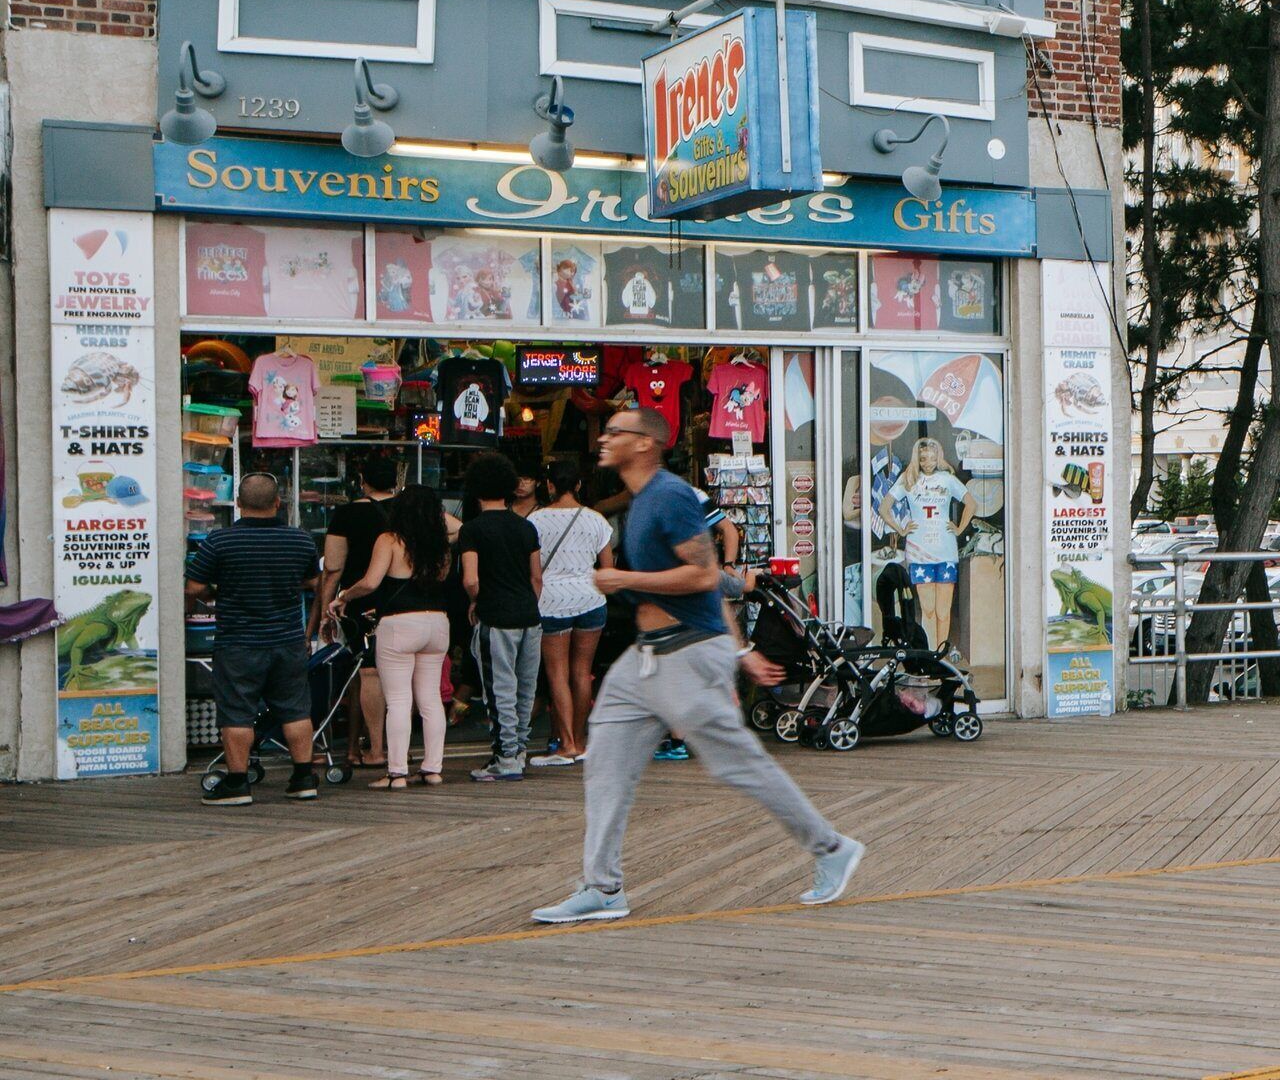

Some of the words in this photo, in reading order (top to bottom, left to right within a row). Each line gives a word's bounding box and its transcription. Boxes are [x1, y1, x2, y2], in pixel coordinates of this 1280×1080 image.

[237, 96, 301, 119] 1239
[653, 34, 745, 177] Irene's
[693, 136, 714, 161] Gifts
[717, 131, 724, 152] &
[187, 149, 440, 203] Souvenirs
[668, 146, 748, 204] Souvenirs
[894, 198, 996, 235] Gifts
[74, 271, 130, 286] TOYS
[55, 295, 150, 311] JEWELRY
[76, 324, 132, 336] HERMIT
[80, 337, 128, 348] CRABS
[523, 353, 565, 368] JERSEY
[1060, 350, 1096, 359] HERMIT
[1063, 361, 1094, 369] CRABS
[558, 365, 597, 378] SHORE
[922, 386, 961, 415] GIFTS
[465, 404, 478, 412] YOU
[60, 425, 149, 438] T-SHIRTS
[1051, 432, 1108, 442] T-SHIRTS
[67, 442, 85, 455] &
[91, 442, 144, 455] HATS
[1055, 445, 1065, 456] &
[1071, 446, 1104, 456] HATS
[1054, 508, 1106, 518] LARGEST
[66, 519, 146, 531] LARGEST
[65, 533, 128, 542] SELECTION
[133, 533, 149, 541] OF
[63, 542, 133, 552] SOUVENIRS
[137, 542, 150, 550] IN
[63, 552, 121, 561] ATLANTIC
[126, 551, 150, 559] CITY
[106, 561, 114, 569] &
[120, 561, 136, 569] UP
[73, 574, 142, 586] IGUANAS
[1069, 657, 1091, 668] ALL
[1062, 669, 1100, 681] BEACH
[92, 703, 125, 715] ALL
[79, 717, 139, 731] BEACH
[67, 731, 150, 748] SUPPLIES
[75, 747, 107, 756] OOGIE
[109, 746, 146, 754] BOARDS
[107, 754, 143, 762] TOWELS
[109, 761, 148, 770] LOTIONS
